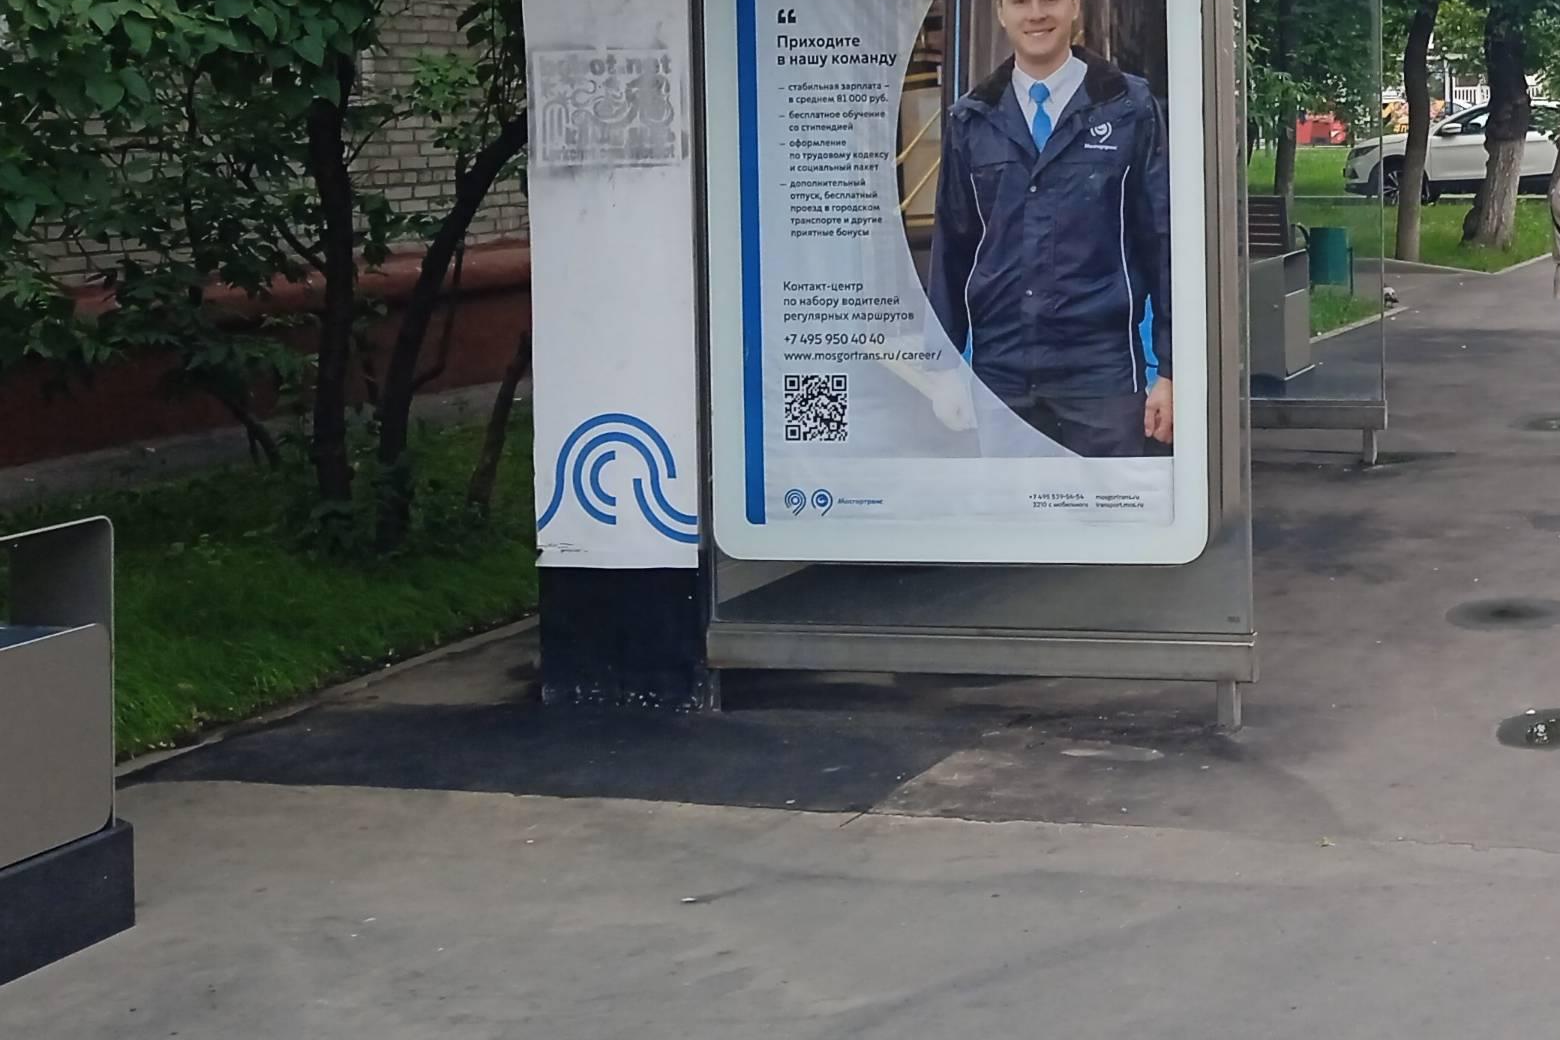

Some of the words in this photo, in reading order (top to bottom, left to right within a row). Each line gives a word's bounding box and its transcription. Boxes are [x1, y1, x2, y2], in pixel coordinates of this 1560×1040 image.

[777, 35, 860, 51] Приходите
[777, 56, 785, 65] в
[790, 54, 828, 68] нашу
[832, 53, 897, 67] команду
[788, 82, 839, 92] стабильная
[841, 83, 881, 92] зарплата
[796, 96, 835, 105] среднем
[849, 94, 867, 103] 000
[869, 94, 888, 105] руб.
[789, 110, 840, 119] бесплатное
[842, 110, 885, 120] обучение
[789, 124, 799, 132] со
[801, 122, 853, 132] стипендией
[789, 139, 847, 148] оформление
[803, 152, 851, 161] трудовому
[853, 151, 889, 160] кодексу
[797, 163, 851, 172] социальный
[790, 178, 866, 188] дополнительный
[790, 192, 822, 201] отпуск,
[824, 191, 878, 200] бесплатный
[790, 205, 822, 213] проезд
[831, 204, 880, 213] городском
[791, 217, 842, 225] транспорте
[851, 216, 882, 225] другие
[791, 229, 834, 238] приятные
[836, 228, 869, 238] бонусы
[783, 281, 864, 293] Контакт-центр
[783, 297, 797, 306] по
[799, 296, 839, 308] набору
[841, 295, 900, 306] водителей
[783, 313, 849, 323] регулярных
[851, 312, 915, 323] маршрутов
[784, 334, 797, 344] +7
[800, 334, 822, 344] 495
[825, 334, 849, 344] 950
[851, 334, 867, 344] 40
[869, 333, 885, 344] 40
